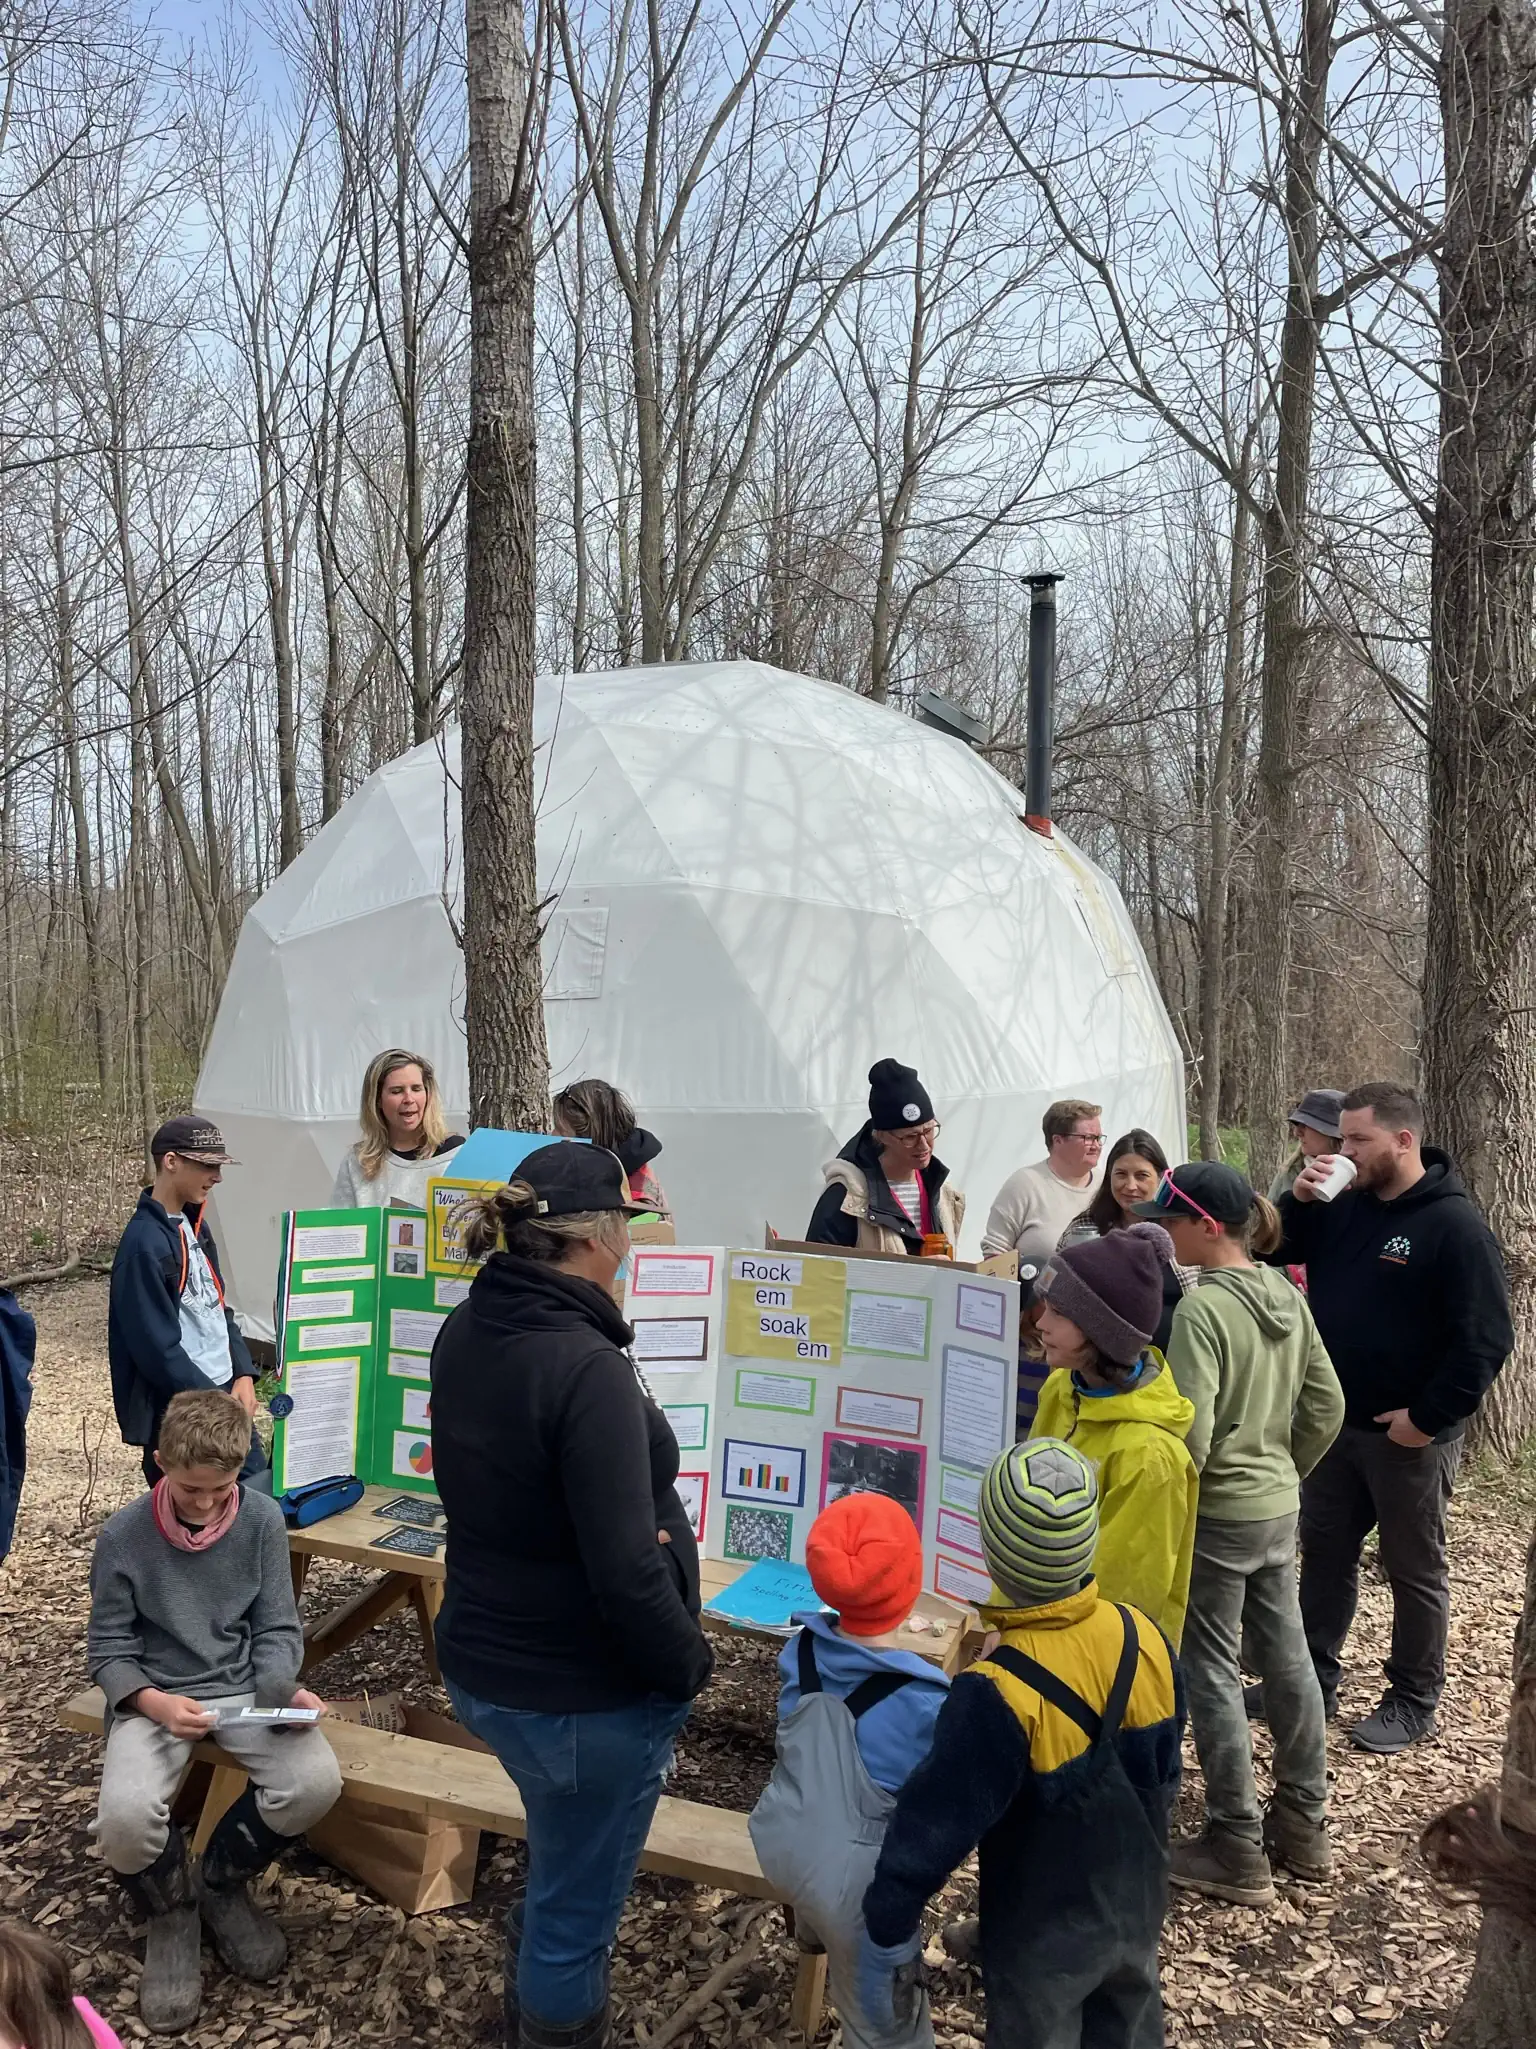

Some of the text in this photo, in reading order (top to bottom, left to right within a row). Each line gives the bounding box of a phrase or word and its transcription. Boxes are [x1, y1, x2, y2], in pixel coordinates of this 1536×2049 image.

[741, 1261, 791, 1282] Rock
[756, 1289, 786, 1306] em
[760, 1317, 807, 1336] soak
[797, 1341, 827, 1358] em
